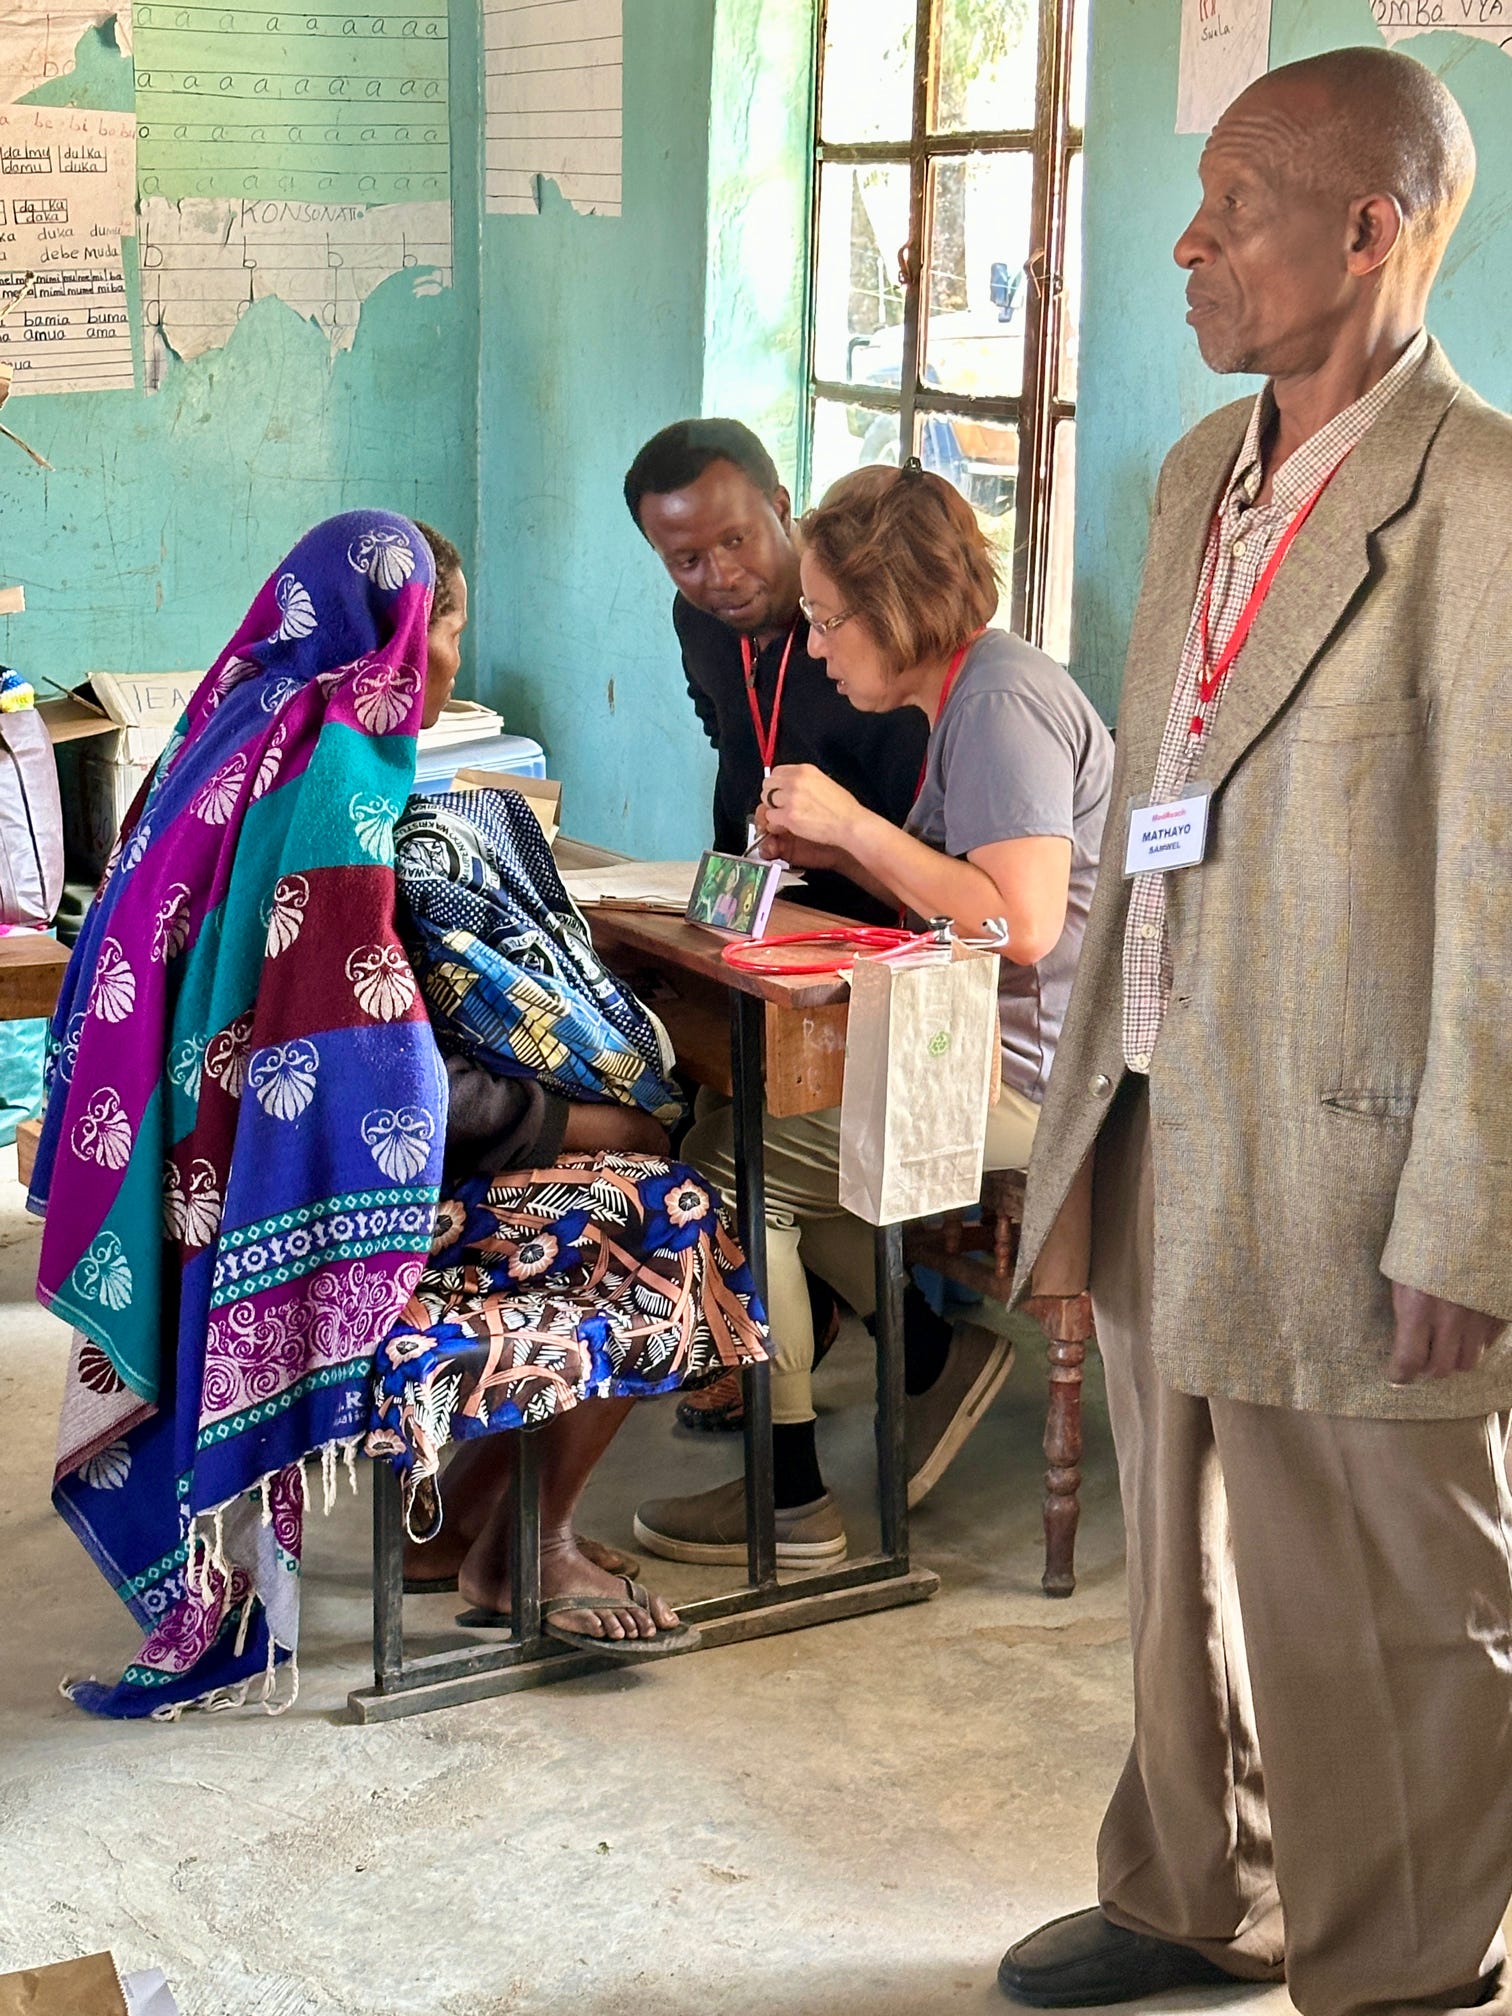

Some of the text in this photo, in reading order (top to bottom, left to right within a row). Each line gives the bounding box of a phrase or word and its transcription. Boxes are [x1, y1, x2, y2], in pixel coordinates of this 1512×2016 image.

[40, 245, 79, 263] debe
[24, 311, 71, 327] bamia
[88, 308, 129, 324] buma
[87, 327, 117, 338] ama
[1142, 823, 1192, 843] MATHAYO
